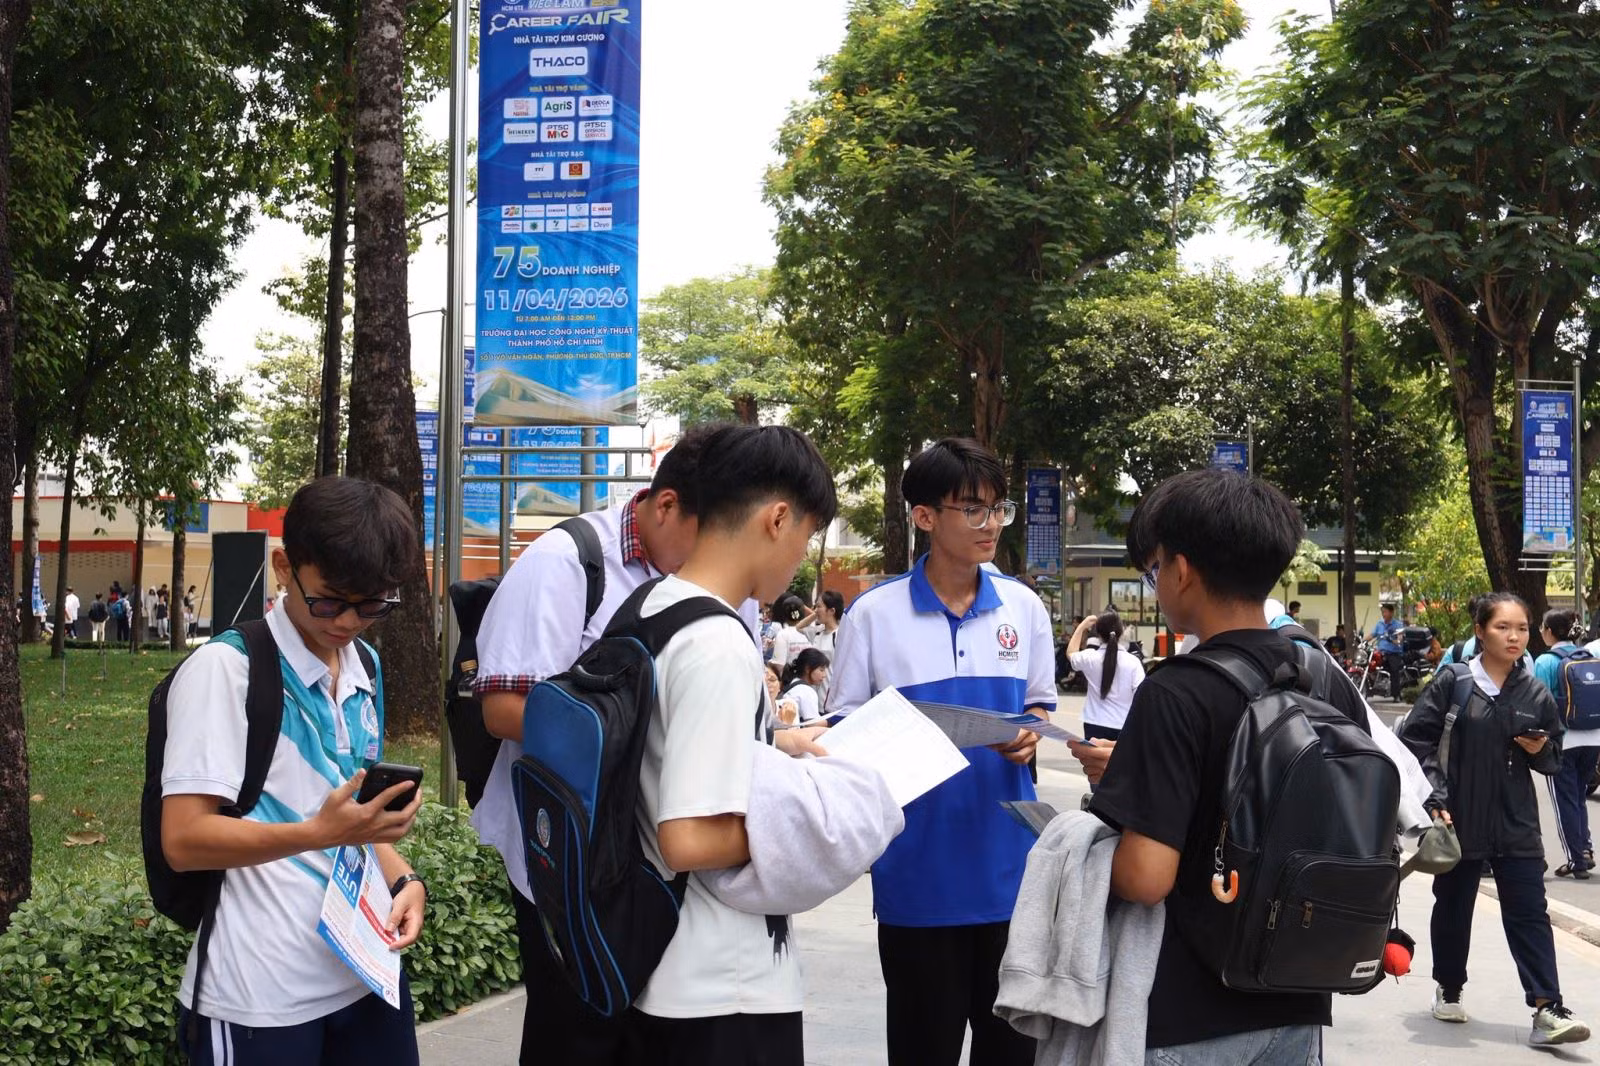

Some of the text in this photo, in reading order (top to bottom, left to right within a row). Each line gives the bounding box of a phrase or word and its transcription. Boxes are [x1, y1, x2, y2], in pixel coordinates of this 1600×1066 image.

[488, 8, 631, 35] CAREER FAIR
[513, 33, 605, 44] NHÀ TÀI TRỢ KIM CƯƠNG
[533, 56, 585, 67] THACO
[544, 101, 573, 113] AgriS
[493, 246, 542, 278] 75
[542, 262, 621, 277] DOANH NGHIỆP
[484, 287, 629, 312] 11/04/2026
[481, 329, 512, 337] TRƯỜNG
[529, 329, 547, 337] HỌC
[549, 327, 573, 336] CÔNG
[575, 326, 596, 337] NGHỆ
[610, 326, 633, 335] THUẬT
[535, 338, 552, 346] PHỐ
[336, 862, 357, 897] UTE
